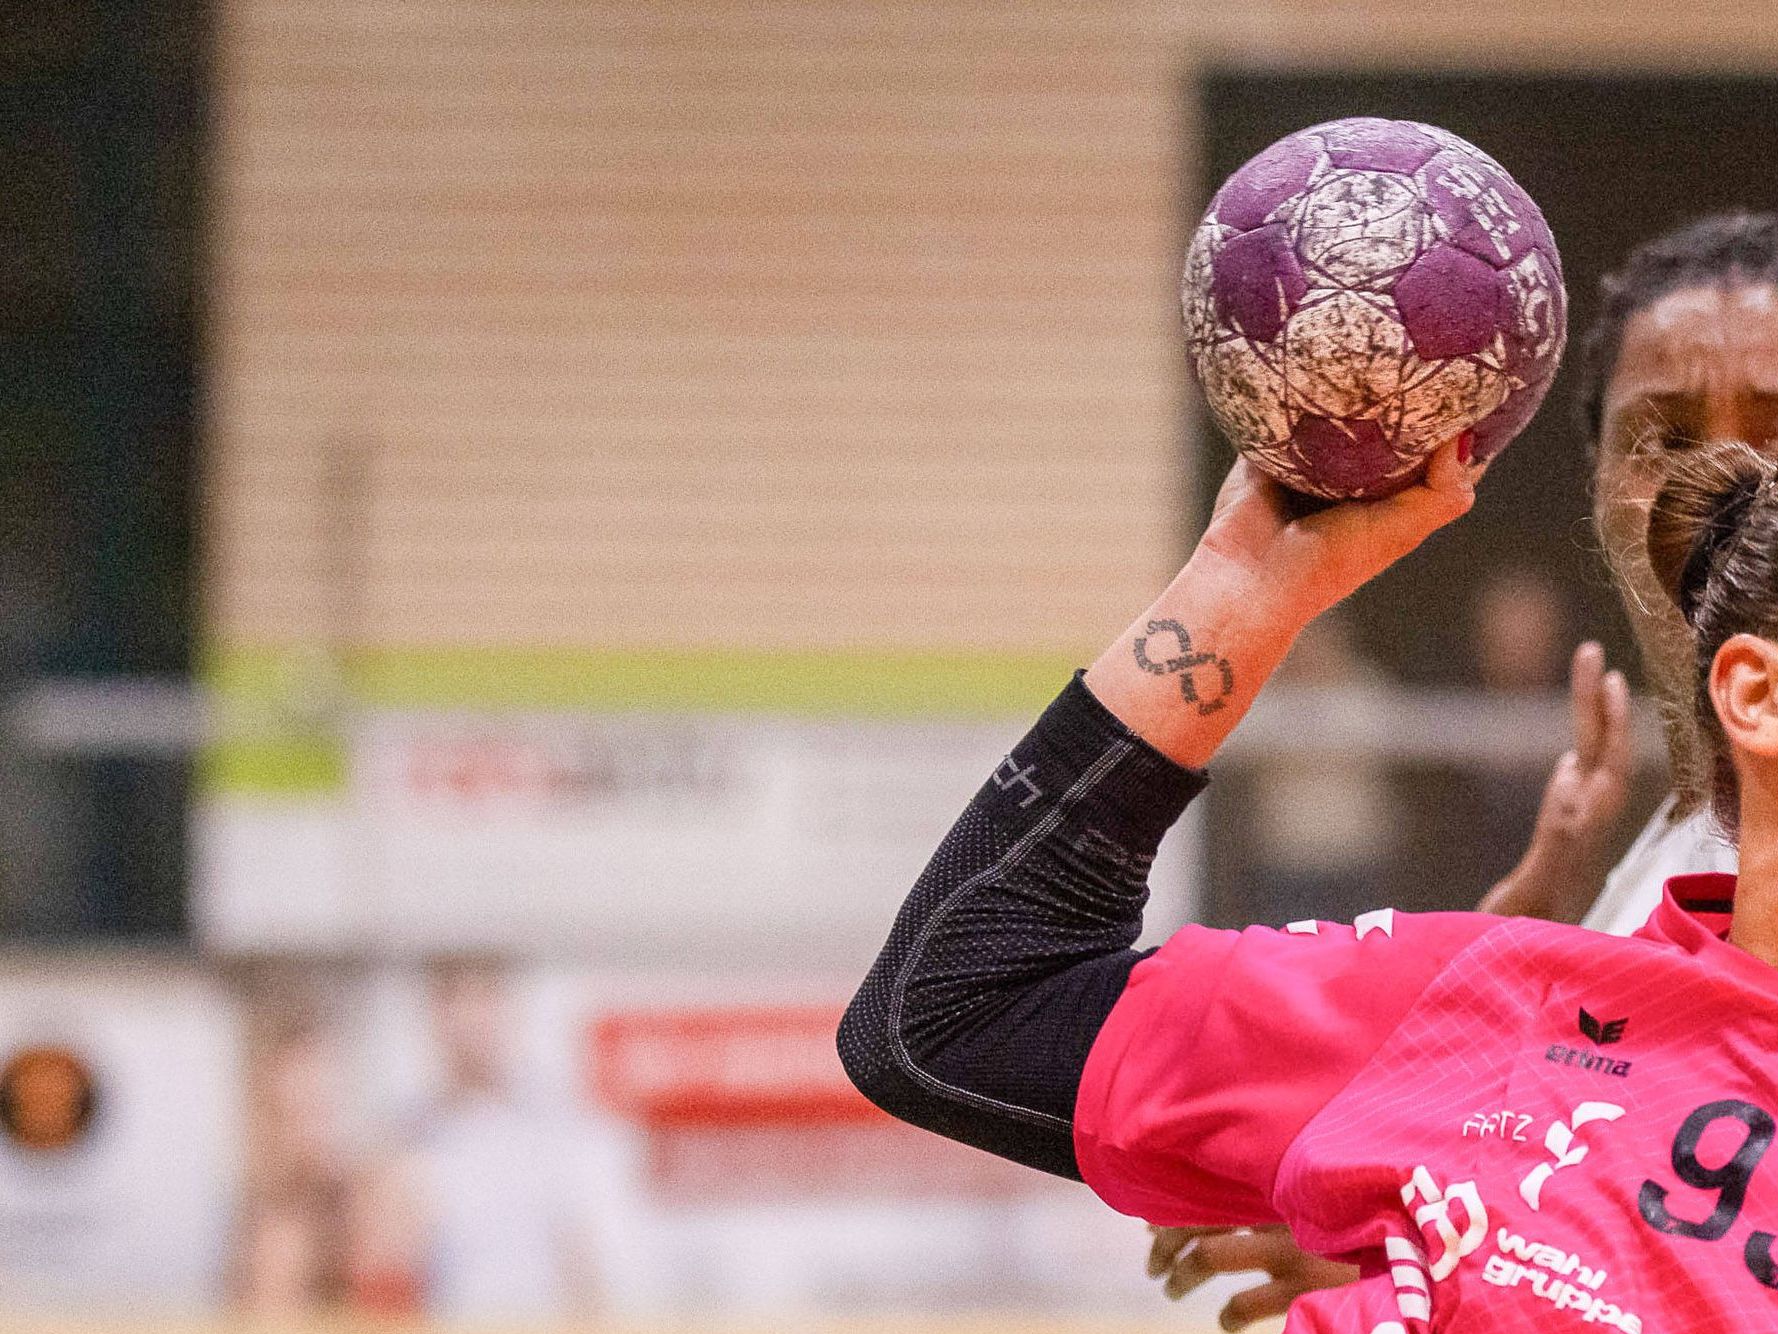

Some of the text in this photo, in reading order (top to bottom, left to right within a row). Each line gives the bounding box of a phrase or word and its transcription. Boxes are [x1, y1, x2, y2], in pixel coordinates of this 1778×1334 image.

[1545, 1044, 1633, 1078] erima
[1462, 1110, 1534, 1143] FATZ
[1496, 1227, 1608, 1291] wahl
